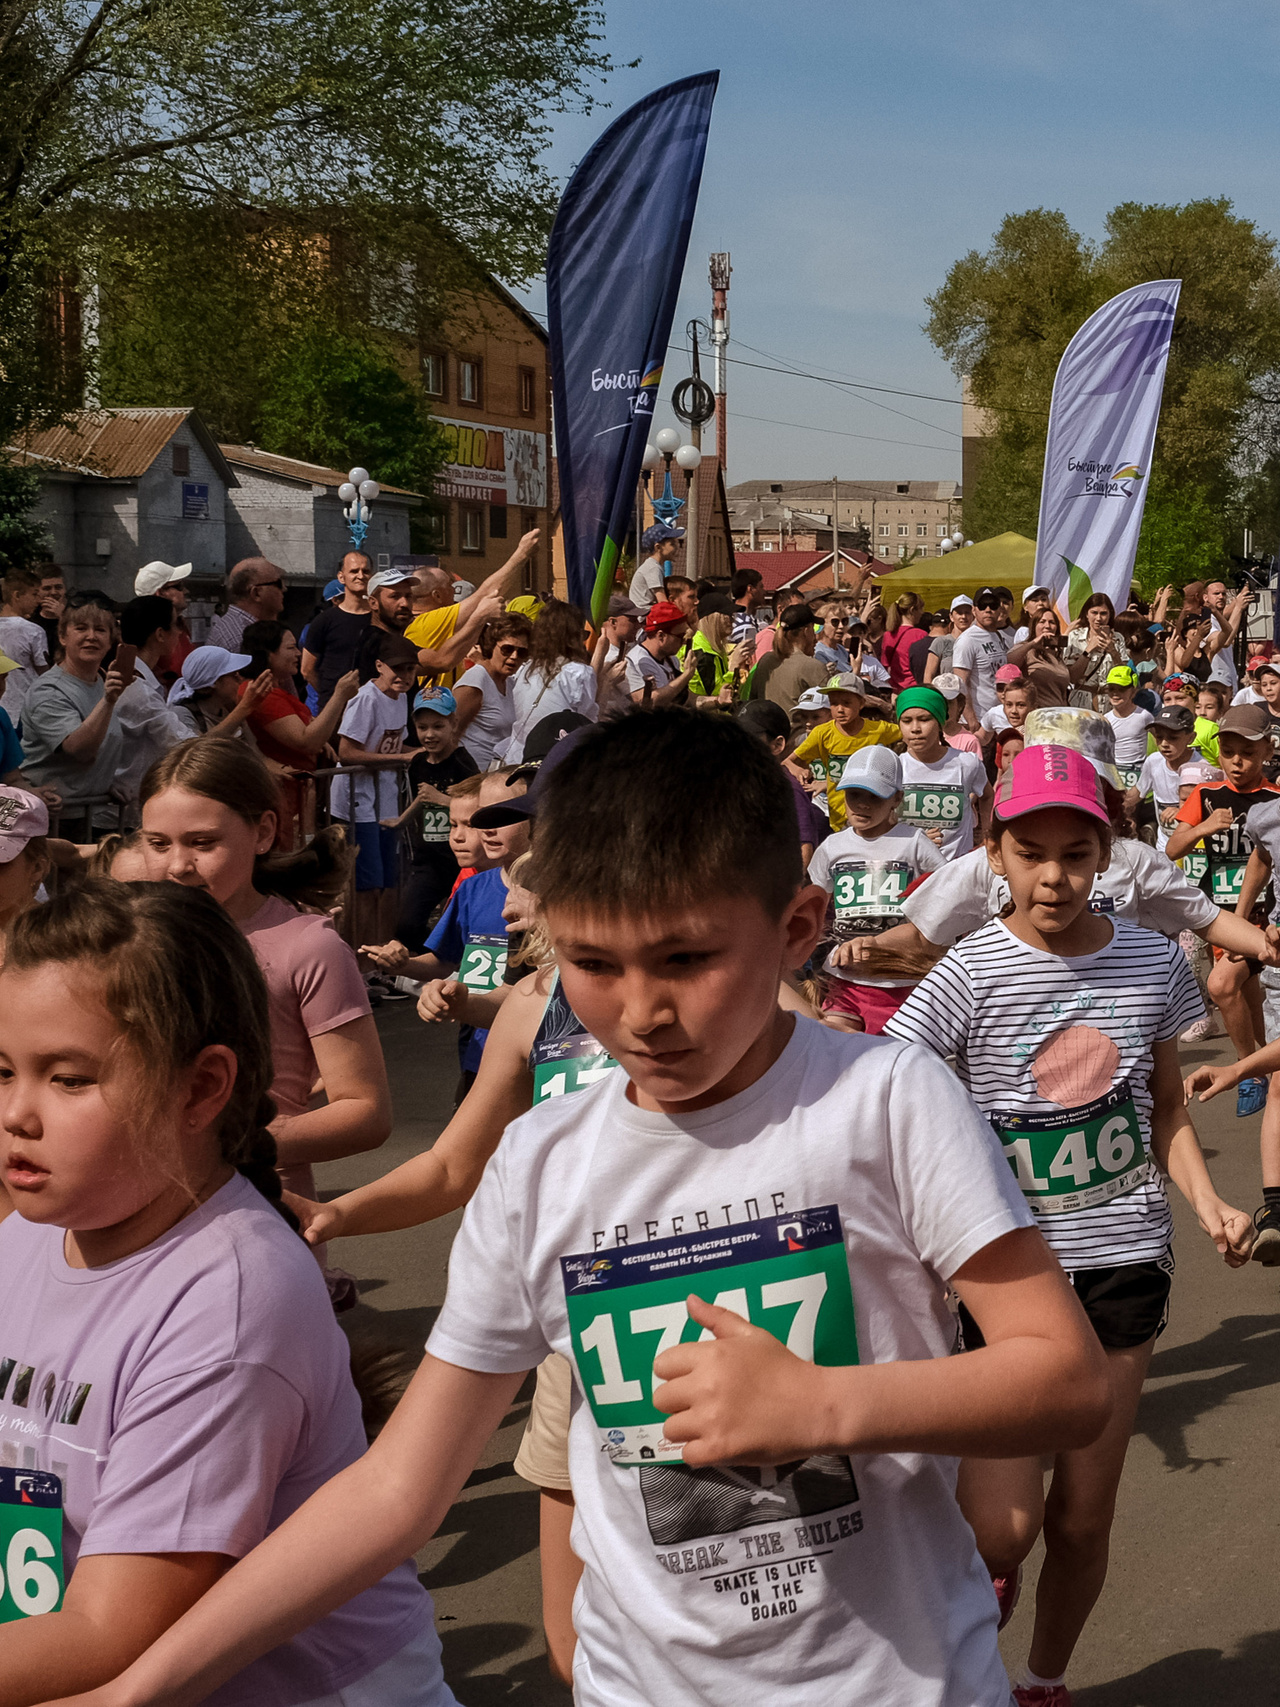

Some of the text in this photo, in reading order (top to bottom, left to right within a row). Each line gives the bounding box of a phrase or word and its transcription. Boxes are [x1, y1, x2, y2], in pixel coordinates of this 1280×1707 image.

[1068, 456, 1112, 479] Быстрее
[1085, 477, 1118, 498] Ветра
[903, 793, 960, 818] 188
[836, 873, 903, 905] 314
[1013, 993, 1142, 1060] MERMAID
[1004, 1115, 1135, 1191] 146
[621, 1251, 667, 1266] ФЕСТИВАЛЬ
[667, 1246, 688, 1258] БЕГА
[739, 1532, 784, 1560] THE
[794, 1511, 864, 1547] RULES
[714, 1559, 817, 1592] SKATE IS LIFE
[740, 1579, 804, 1606] ON THE
[751, 1599, 797, 1621] BOARD
